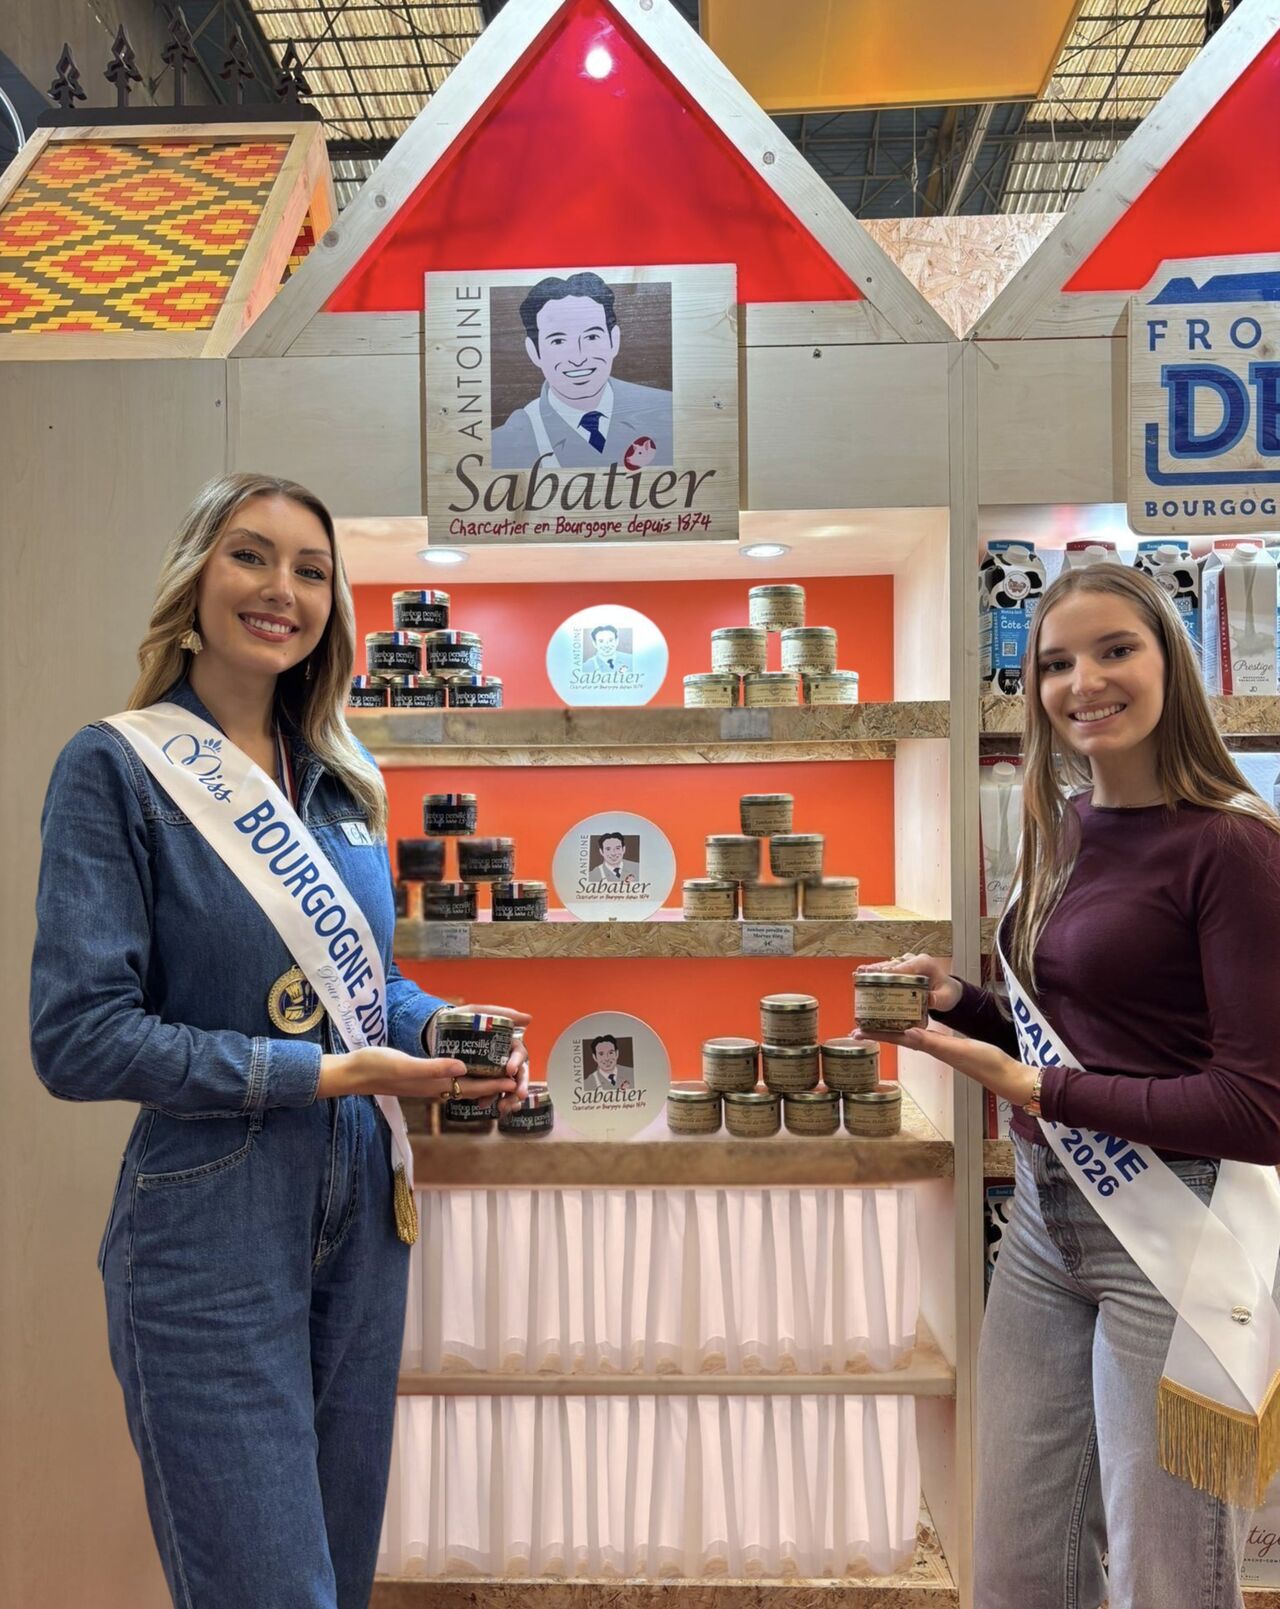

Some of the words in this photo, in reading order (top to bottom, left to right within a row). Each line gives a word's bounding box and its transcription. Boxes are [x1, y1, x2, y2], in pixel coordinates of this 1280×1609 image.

[456, 285, 483, 441] ANTOINE
[448, 453, 716, 513] Sabatier
[449, 518, 529, 536] Charcutier
[534, 522, 550, 534] en
[555, 516, 622, 538] Bourgogne
[627, 514, 672, 536] depuis
[677, 512, 712, 532] 1874
[569, 669, 645, 684] Sabatier
[1233, 660, 1273, 675] Prestige
[161, 733, 235, 804] Miss
[233, 799, 373, 999] BOURGOGNE
[580, 835, 588, 876] ANTOINE
[576, 878, 651, 893] Sabatier
[573, 1039, 581, 1083] ANTOINE
[572, 1086, 646, 1104] Sabatier
[1060, 1129, 1120, 1197] 2026
